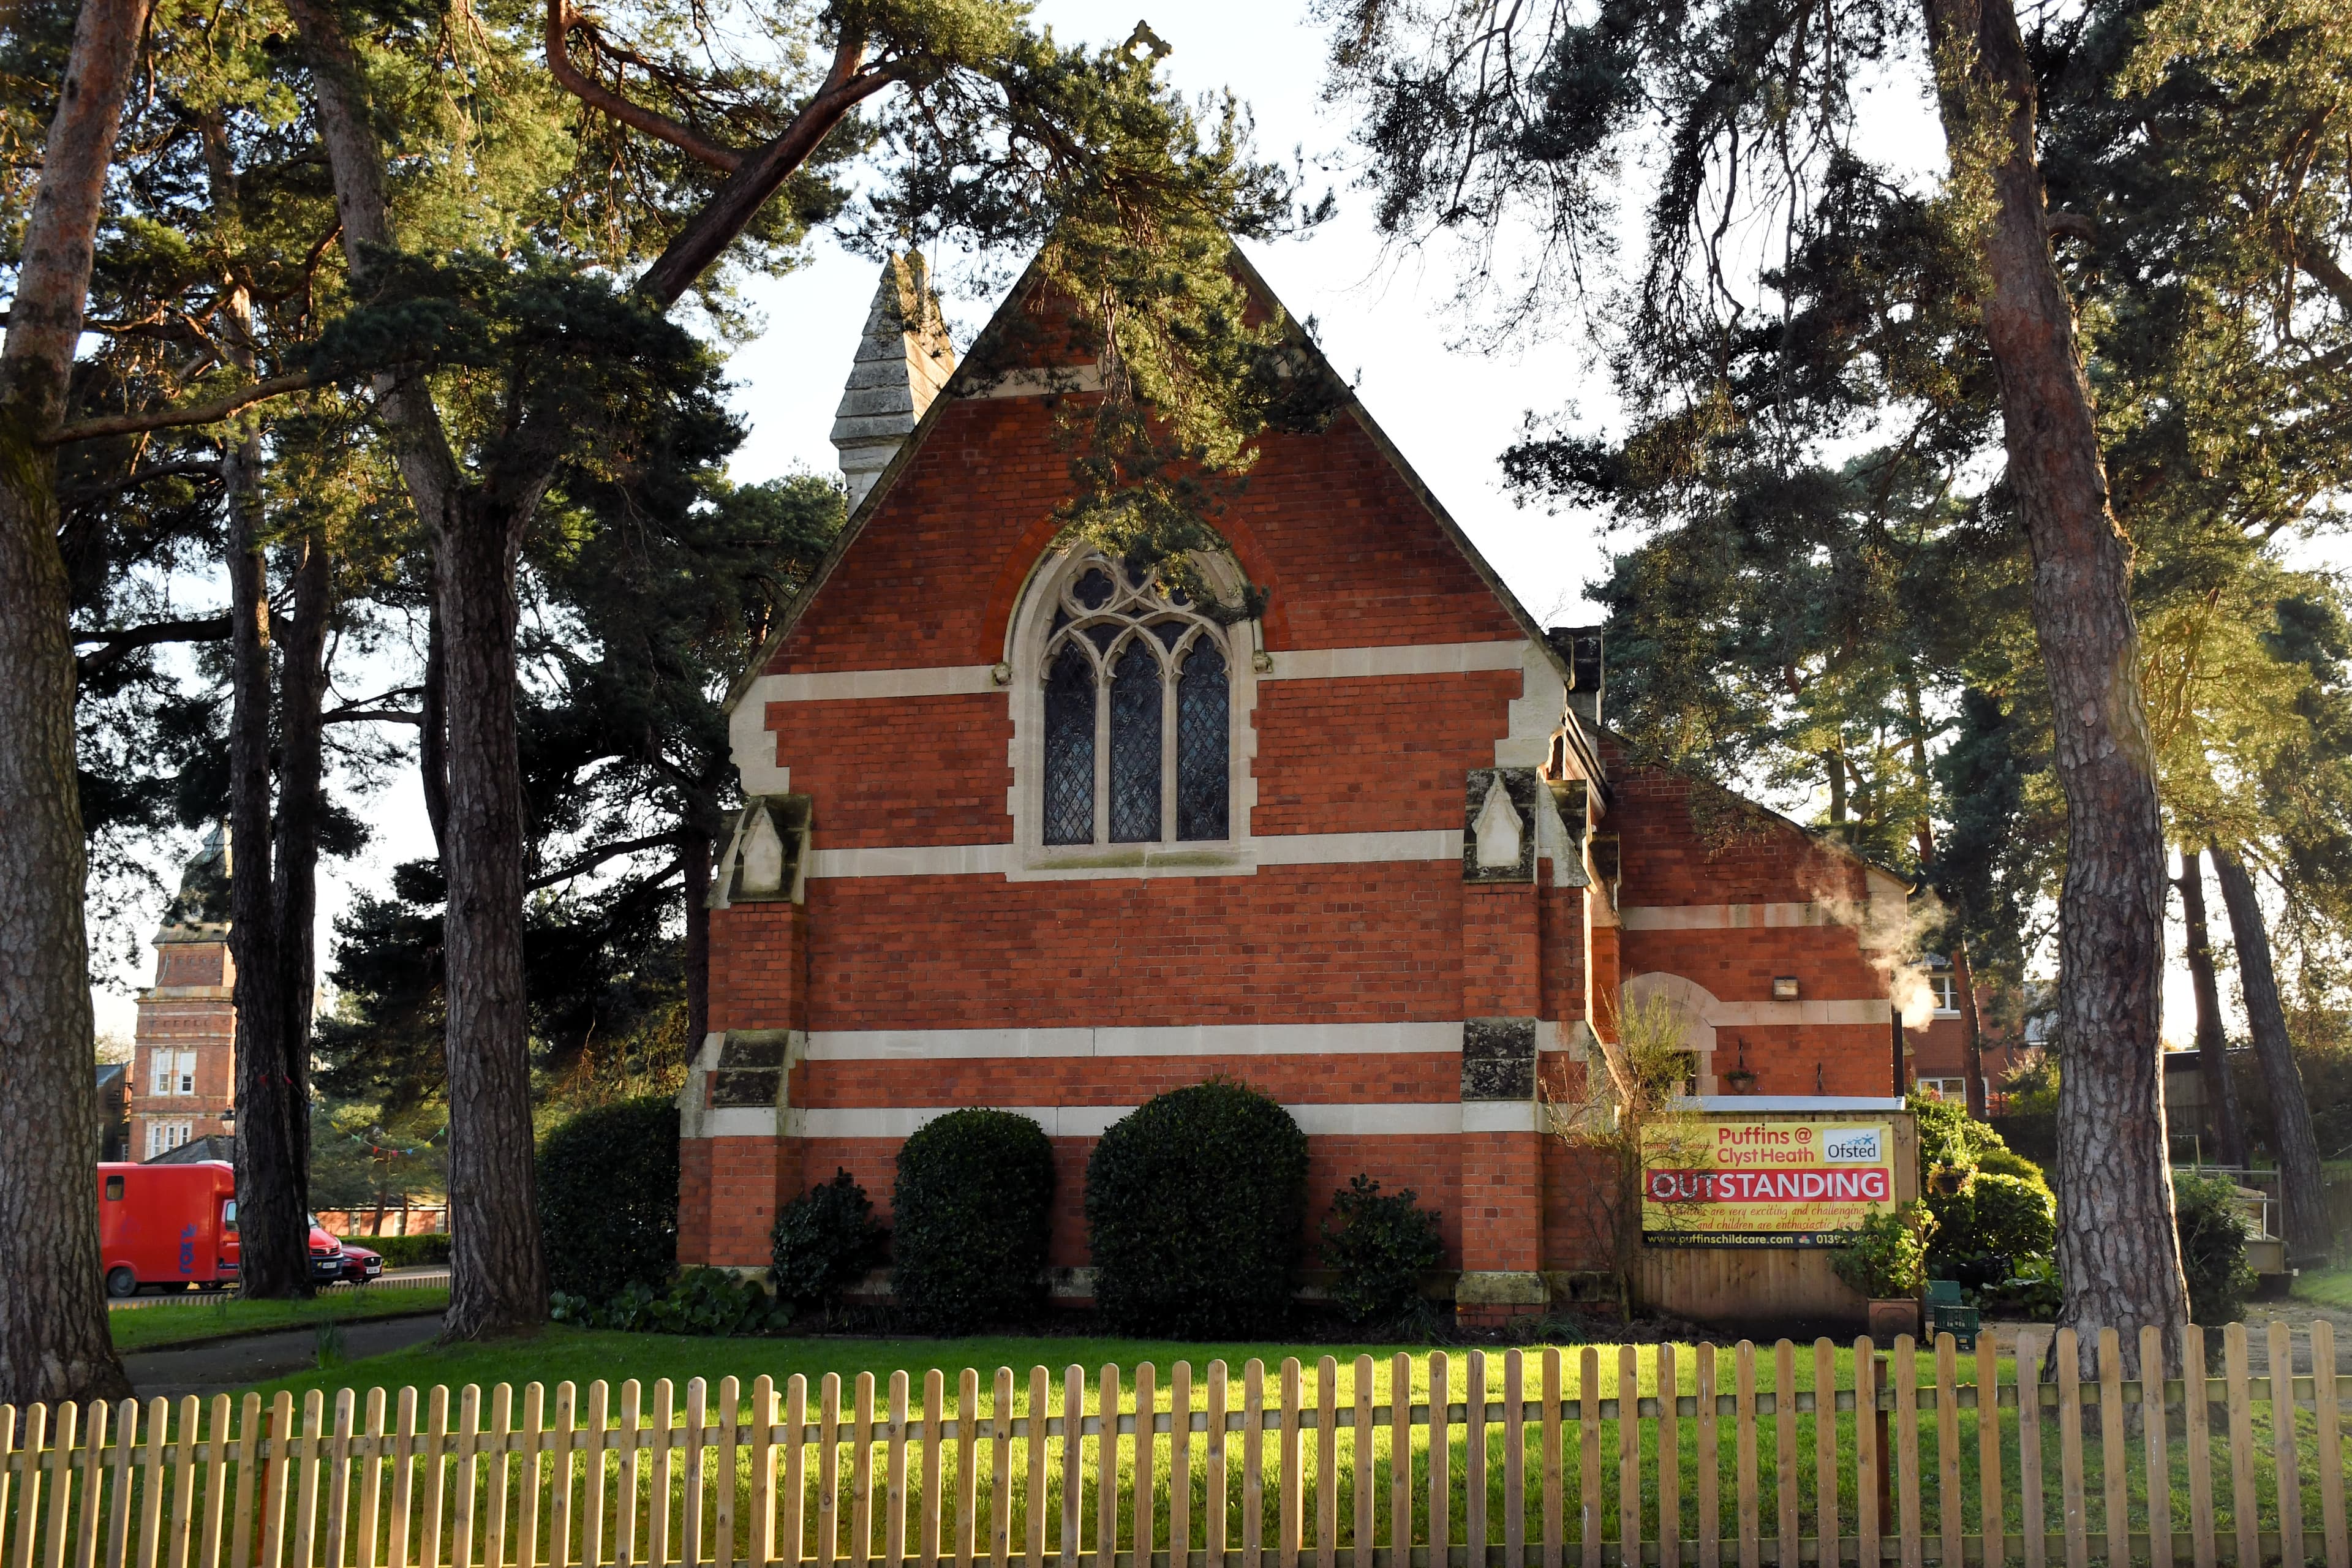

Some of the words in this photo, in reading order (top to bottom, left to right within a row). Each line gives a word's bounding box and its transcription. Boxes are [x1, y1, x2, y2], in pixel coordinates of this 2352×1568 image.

[1719, 1126, 1790, 1145] Puffins
[1795, 1127, 1812, 1144] @
[1717, 1147, 1758, 1167] Clyst
[1761, 1147, 1814, 1163] Heath
[1828, 1144, 1876, 1158] Ofsted
[1652, 1172, 1884, 1198] OUTSTANDING
[1729, 1207, 1747, 1219] very
[1751, 1204, 1787, 1219] exciting
[1792, 1203, 1809, 1215] and
[1812, 1202, 1865, 1219] challenging
[1697, 1218, 1714, 1230] and
[1717, 1216, 1753, 1230] children
[1757, 1221, 1771, 1229] are
[1776, 1216, 1832, 1230] enthusiastic
